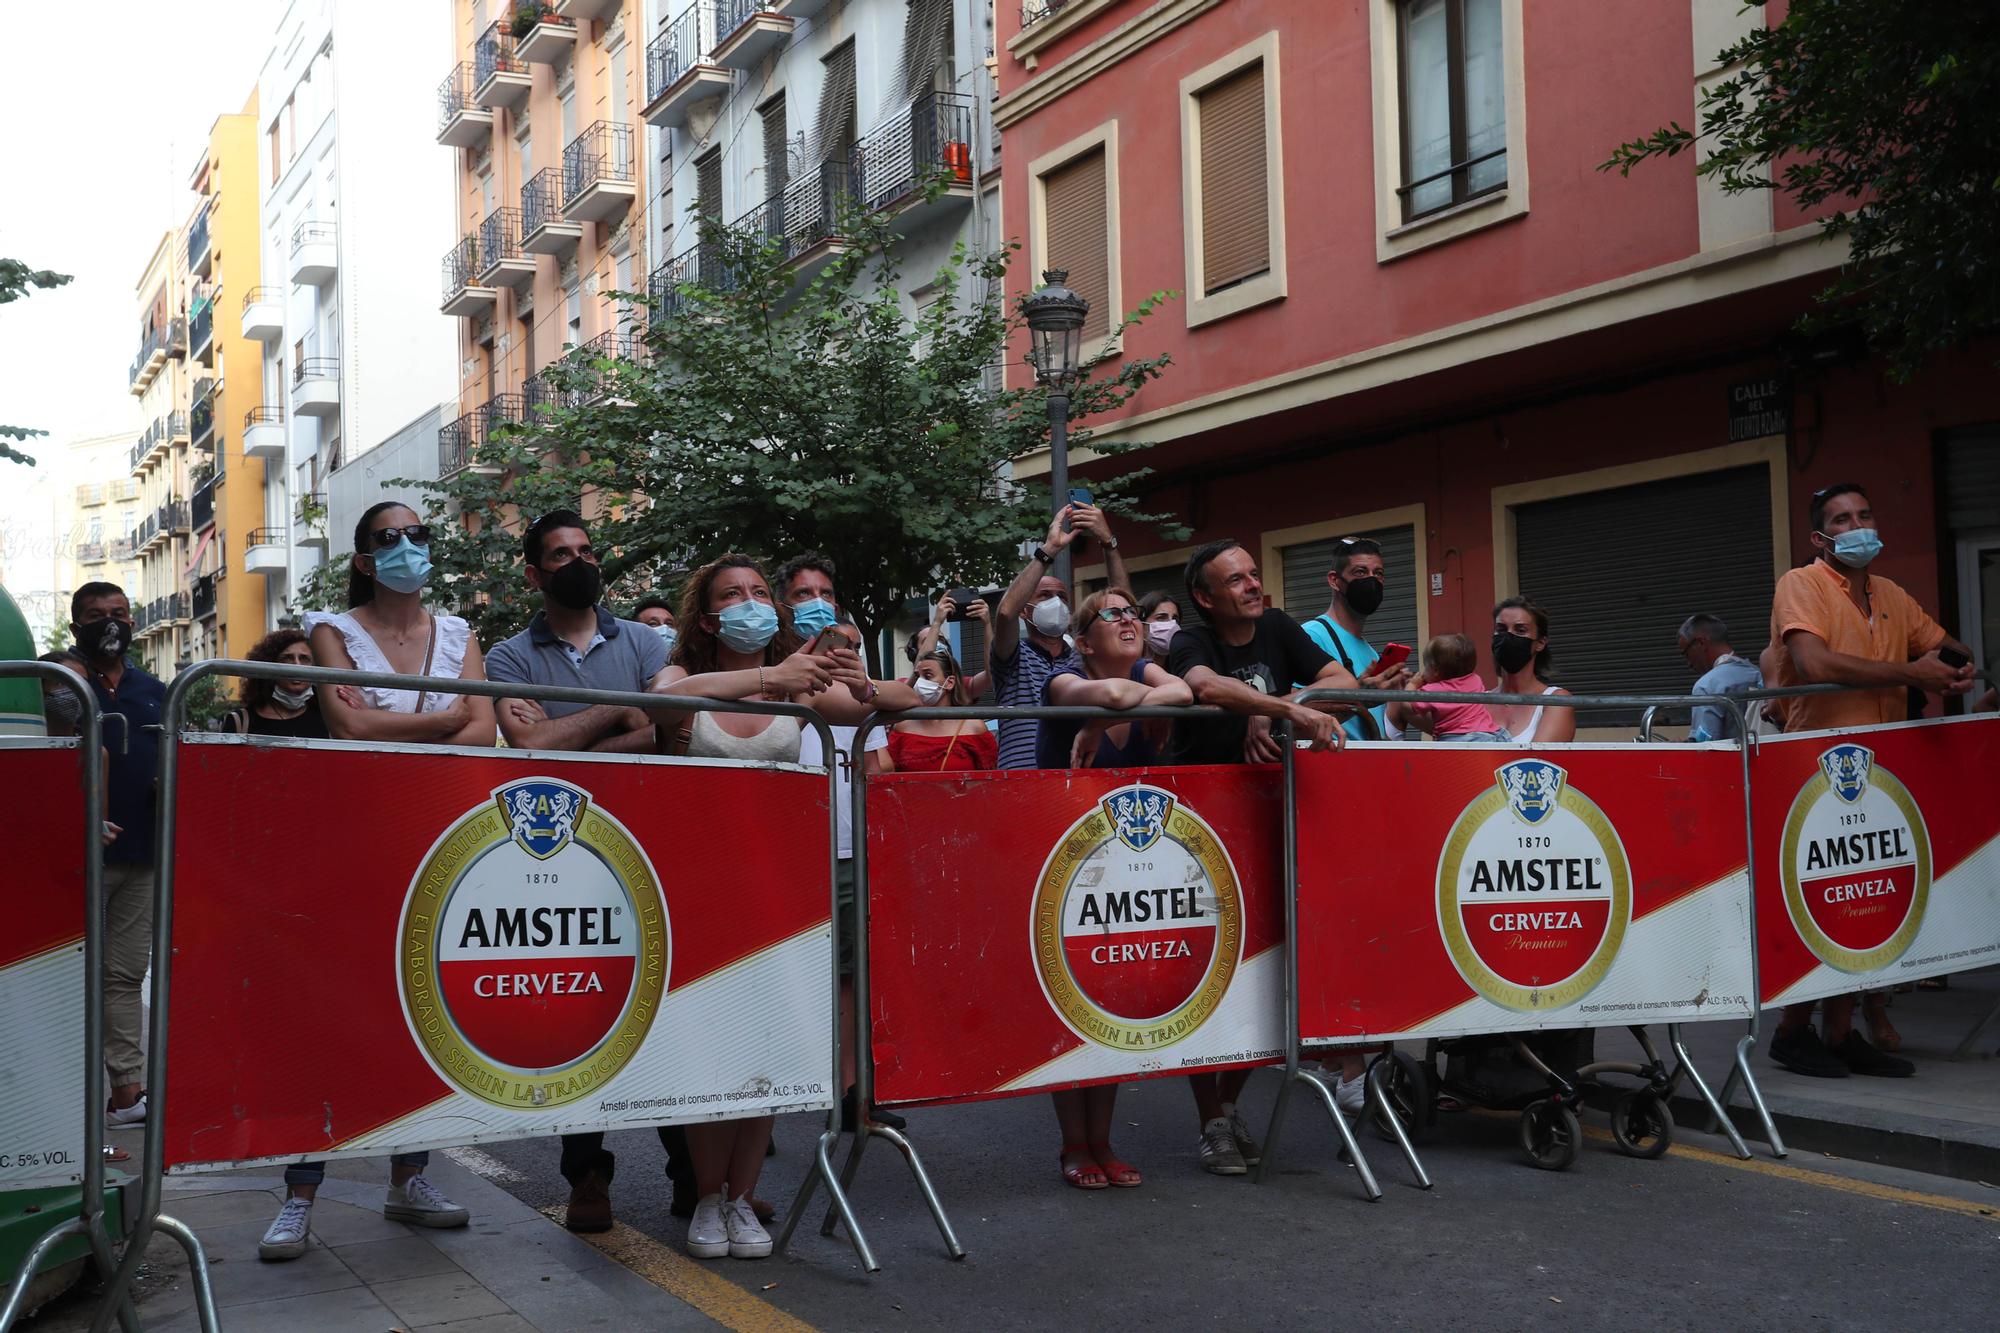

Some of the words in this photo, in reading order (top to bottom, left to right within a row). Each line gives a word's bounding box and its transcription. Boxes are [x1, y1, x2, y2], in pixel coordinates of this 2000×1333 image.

[1735, 379, 1777, 402] CALLE
[1525, 770, 1538, 789] A
[535, 793, 551, 816] A
[1840, 813, 1867, 827] 1870
[1516, 836, 1551, 848] 1870
[425, 814, 499, 899] PREMIUM
[585, 819, 649, 892] QUALITY
[1128, 862, 1154, 873] 1870
[525, 873, 559, 884] 1870
[1824, 877, 1896, 904] CERVEZA
[1489, 911, 1584, 931] CERVEZA
[1091, 940, 1192, 965] CERVEZA
[1503, 934, 1569, 952] Premium
[1040, 900, 1072, 1006] ELABORADA
[1071, 1003, 1120, 1043] SEGUN
[1125, 1030, 1143, 1046] LA
[1148, 983, 1221, 1046] TRADICION
[474, 971, 604, 998] CERVEZA
[409, 912, 448, 1049] ELABORADA
[446, 1048, 508, 1099] SEGUN
[544, 1032, 638, 1100] TRADICION
[634, 995, 651, 1026] DE
[644, 900, 661, 989] AMSTEL
[1637, 1001, 1643, 1010] el
[1643, 1000, 1669, 1009] consumo
[1180, 1056, 1204, 1066] Amstel
[1205, 1052, 1244, 1064] recomienda
[1253, 1049, 1283, 1059] consumo
[600, 1100, 628, 1112] Amstel
[630, 1097, 677, 1109] recomienda
[678, 1095, 686, 1105] el
[687, 1093, 723, 1105] consumo
[793, 1084, 806, 1095] 5%
[18, 1153, 40, 1167] 5%
[42, 1151, 76, 1165] VOL.
